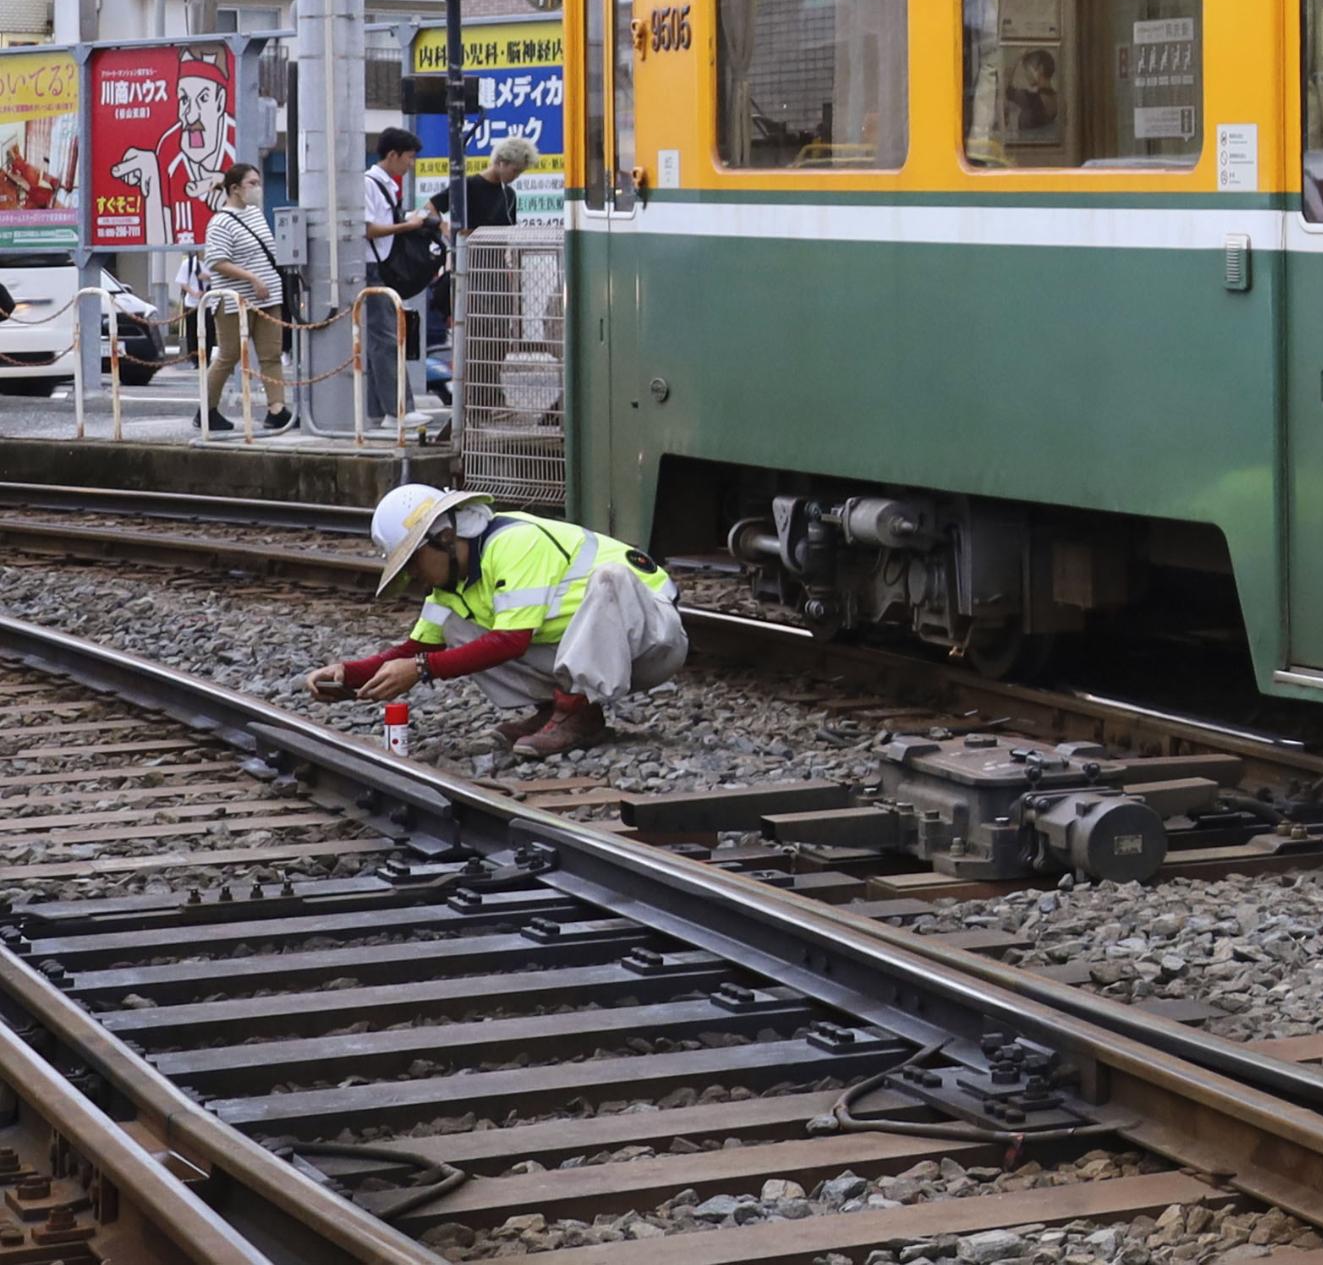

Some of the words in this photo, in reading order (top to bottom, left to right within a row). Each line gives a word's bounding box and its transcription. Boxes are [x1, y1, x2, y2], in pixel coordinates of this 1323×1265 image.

[651, 5, 692, 53] 9505
[0, 64, 74, 97] いてる?
[101, 79, 168, 106] 川商ハウス
[97, 195, 141, 215] すぐそこ!
